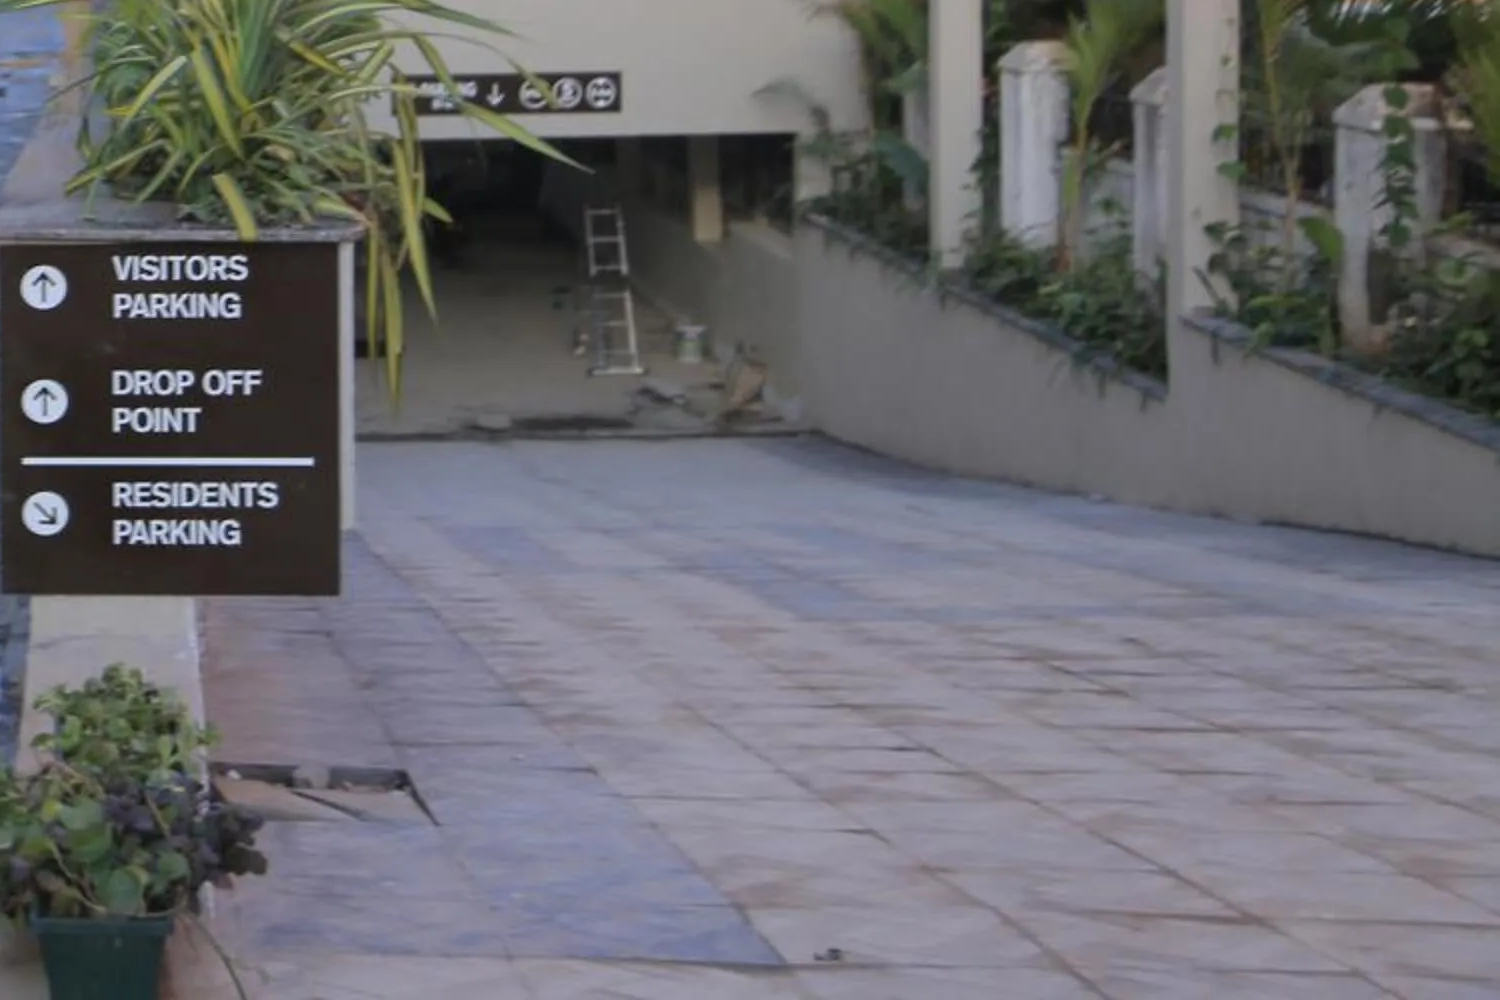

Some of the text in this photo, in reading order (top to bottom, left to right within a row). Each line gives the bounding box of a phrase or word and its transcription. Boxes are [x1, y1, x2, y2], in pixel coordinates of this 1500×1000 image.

[111, 255, 249, 281] VISITORS
[112, 293, 242, 319] PARKING
[112, 370, 263, 396] DROP OFF
[112, 407, 202, 433] POINT
[112, 482, 279, 508] RESIDENTS
[112, 520, 241, 545] PARKING
